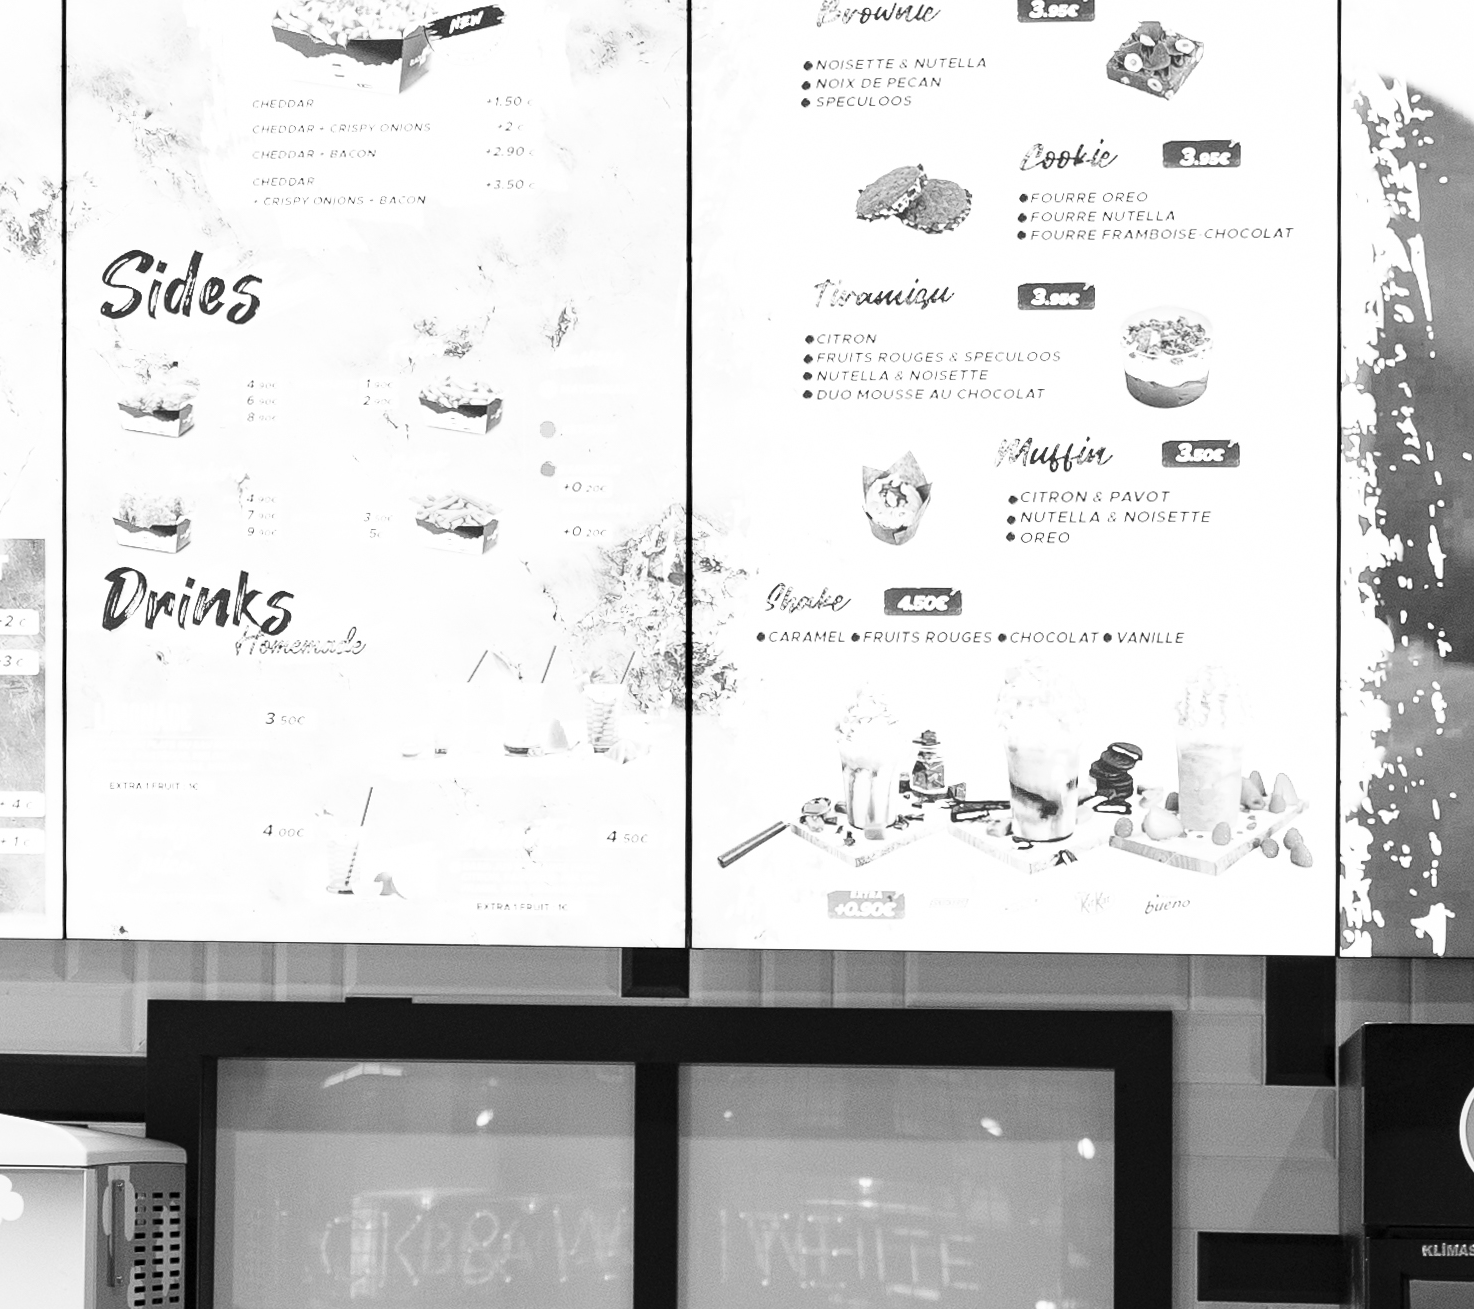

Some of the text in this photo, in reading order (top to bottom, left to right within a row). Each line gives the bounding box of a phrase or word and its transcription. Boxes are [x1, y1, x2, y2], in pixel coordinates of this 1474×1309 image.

[448, 11, 484, 34] NEW
[815, 58, 895, 71] NOISETTE
[914, 57, 987, 69] NUTELLA
[815, 76, 942, 89] NOIX DE PECAN
[252, 98, 314, 109] CHEDDAR
[816, 95, 912, 108] SPECULOOS
[252, 122, 431, 135] CHEDDAR CRISPY ONIONS
[252, 149, 377, 160] CHEDDAR BACON
[1019, 138, 1119, 172] Cookie
[252, 176, 315, 187] CHEDDAR
[1030, 191, 1148, 204] FOURRE OREO
[1030, 210, 1175, 223] FOURRE NUTELLA
[1030, 229, 1097, 242] FOURRE
[99, 249, 263, 325] Sides
[816, 333, 877, 345] CITRON
[816, 352, 872, 364] FRUITS
[877, 351, 944, 363] ROUGES
[964, 350, 1061, 363] SPECULOOS
[816, 370, 889, 382] NUTELLA
[909, 369, 989, 381] NOISETTE
[816, 388, 1046, 401] DUO MOUSSE AU CHOCOLAT
[994, 436, 1114, 473] Muffin
[1020, 490, 1088, 504] CITRON
[1109, 490, 1171, 503] PAVOT
[1020, 510, 1100, 524] NUTELLA
[1123, 510, 1212, 523] NOISETTE
[1020, 531, 1070, 544] OREO
[101, 566, 295, 635] Drinks
[234, 626, 367, 657] Homemade
[768, 630, 1185, 644] CARAMEL FRUITS ROUGES CHOCOLAT VANILLE
